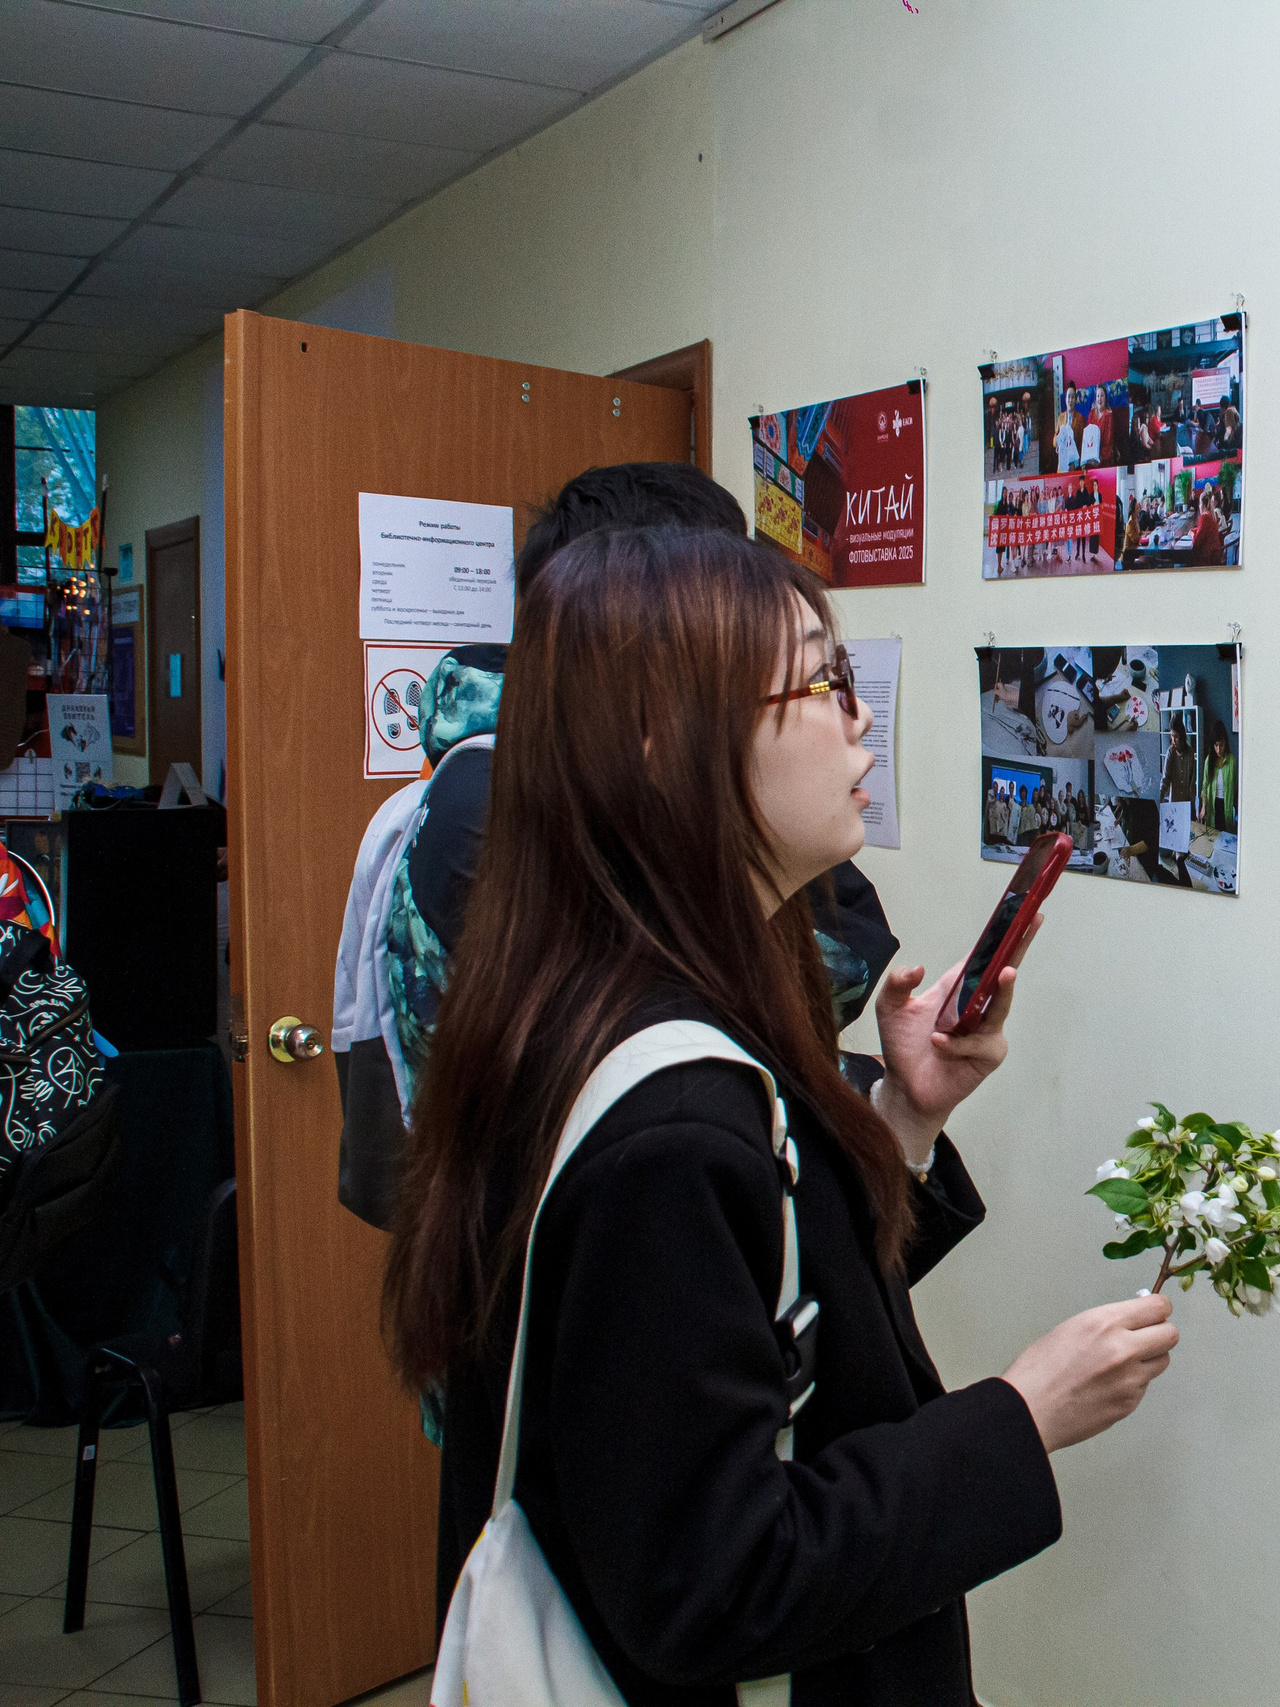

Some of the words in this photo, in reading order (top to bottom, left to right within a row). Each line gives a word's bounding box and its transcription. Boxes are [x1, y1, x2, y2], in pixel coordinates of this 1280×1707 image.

[846, 473, 914, 527] КИТАЙ
[419, 520, 439, 528] Режим
[440, 522, 461, 530] работы
[850, 531, 882, 545] визуальные
[883, 528, 914, 543] модуляции
[849, 547, 897, 563] ФОТОВЫСТАВКА
[898, 546, 914, 560] 2025
[454, 566, 470, 574] 09:00
